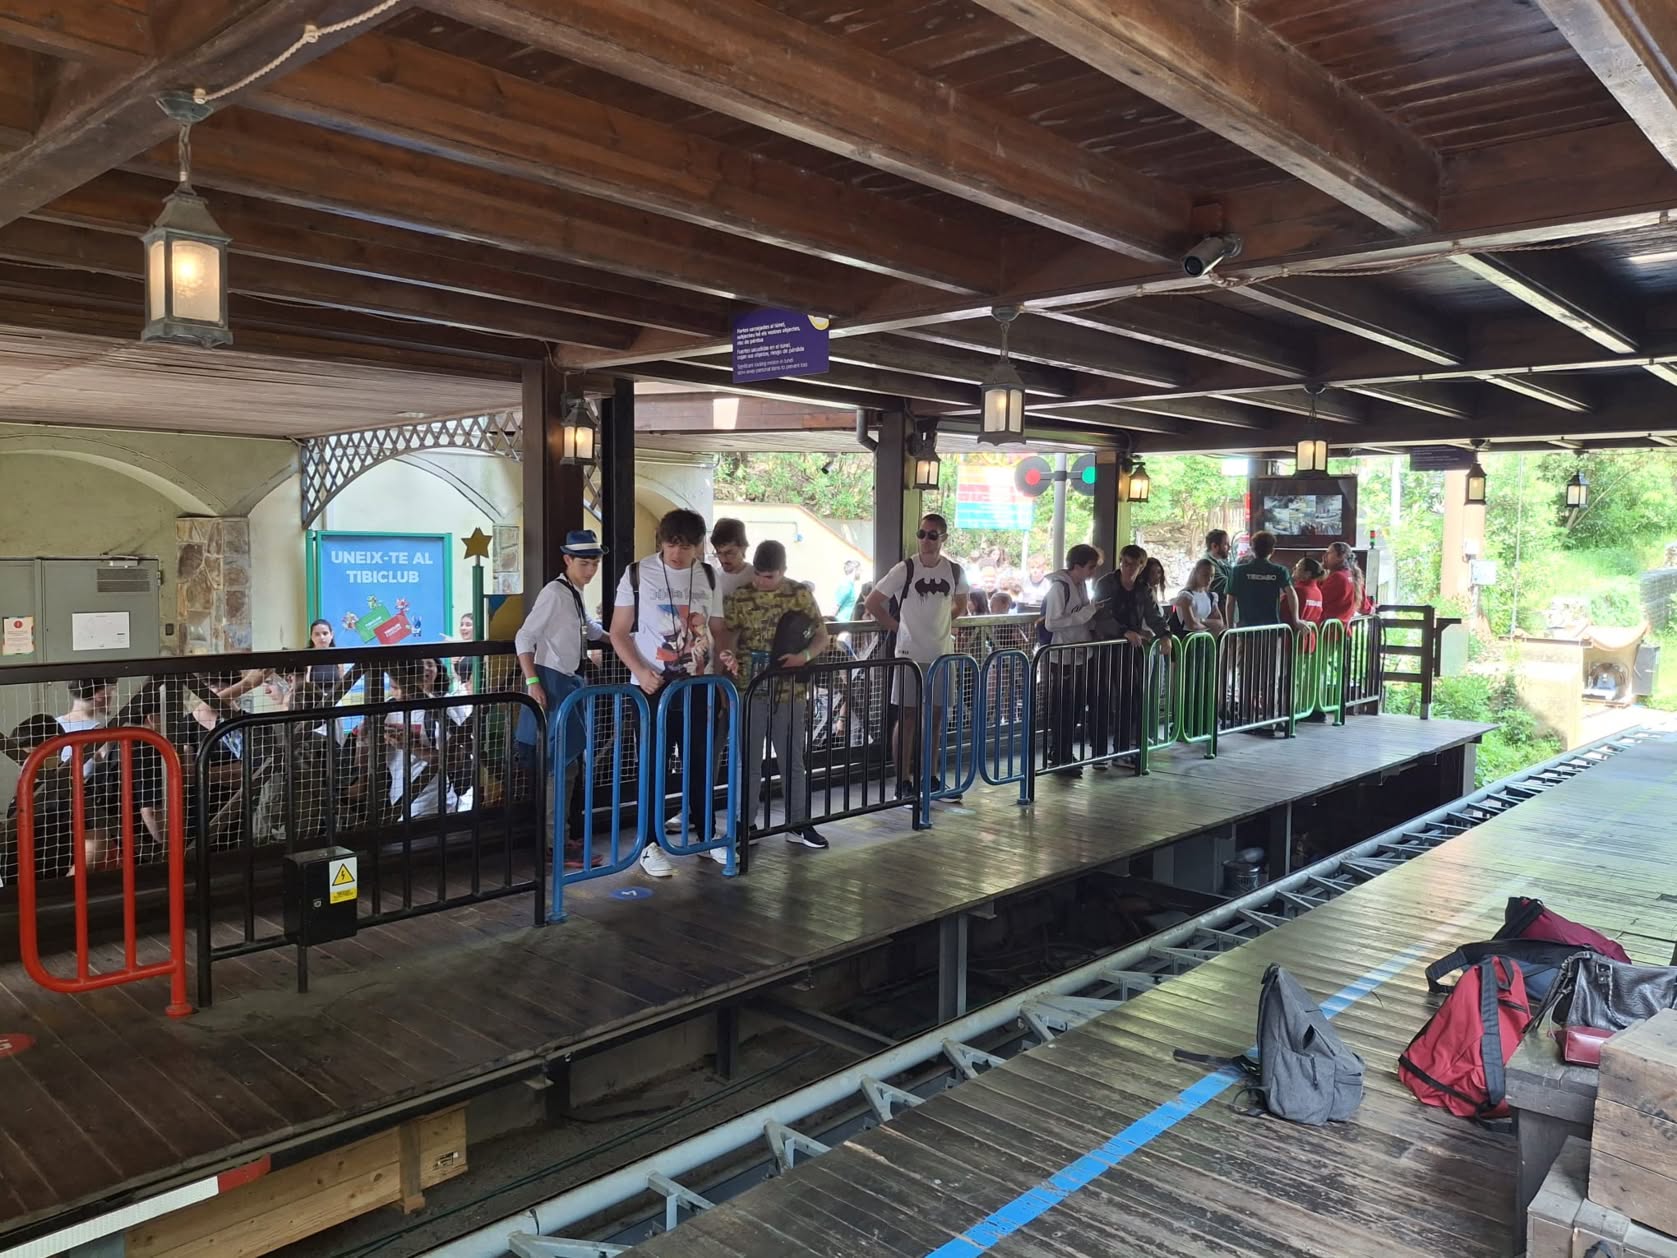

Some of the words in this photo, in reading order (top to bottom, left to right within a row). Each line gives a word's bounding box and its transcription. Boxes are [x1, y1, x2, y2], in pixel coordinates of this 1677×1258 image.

[331, 550, 408, 564] UNEIX-TE
[413, 552, 433, 564] AL
[346, 571, 420, 583] TIBICLUB
